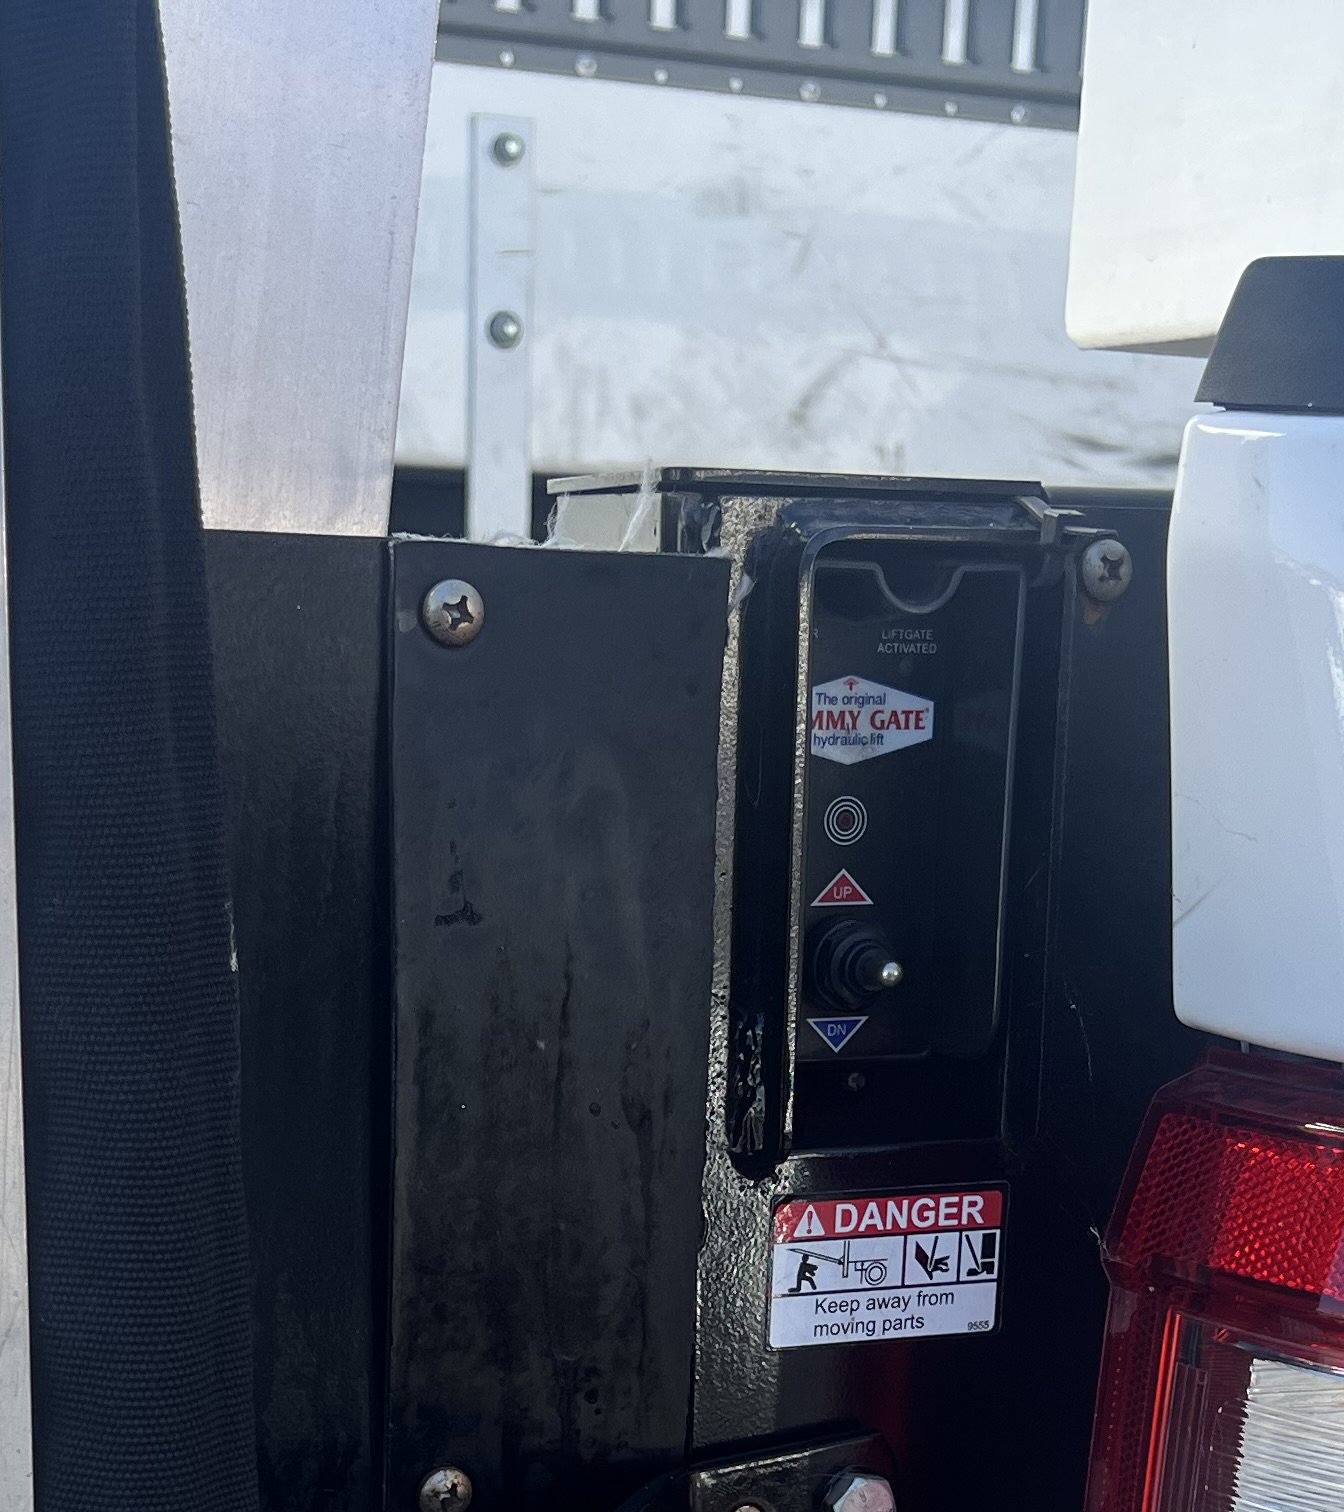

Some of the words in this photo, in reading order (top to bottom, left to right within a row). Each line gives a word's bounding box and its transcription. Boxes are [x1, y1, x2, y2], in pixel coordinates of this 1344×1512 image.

[882, 629, 933, 639] LIFTGATE
[877, 643, 937, 654] ACTIVATED
[816, 693, 838, 705] The
[842, 693, 886, 708] original
[811, 710, 861, 731] MMY
[813, 733, 868, 748] hydraulic
[870, 733, 884, 745] lift
[833, 887, 852, 899] UP
[827, 1024, 846, 1036] DN
[835, 1195, 985, 1233] DANGER
[815, 1297, 860, 1315] Keep
[866, 1294, 911, 1312] away
[917, 1290, 954, 1306] from
[814, 1318, 876, 1337] moving
[882, 1315, 925, 1334] parts
